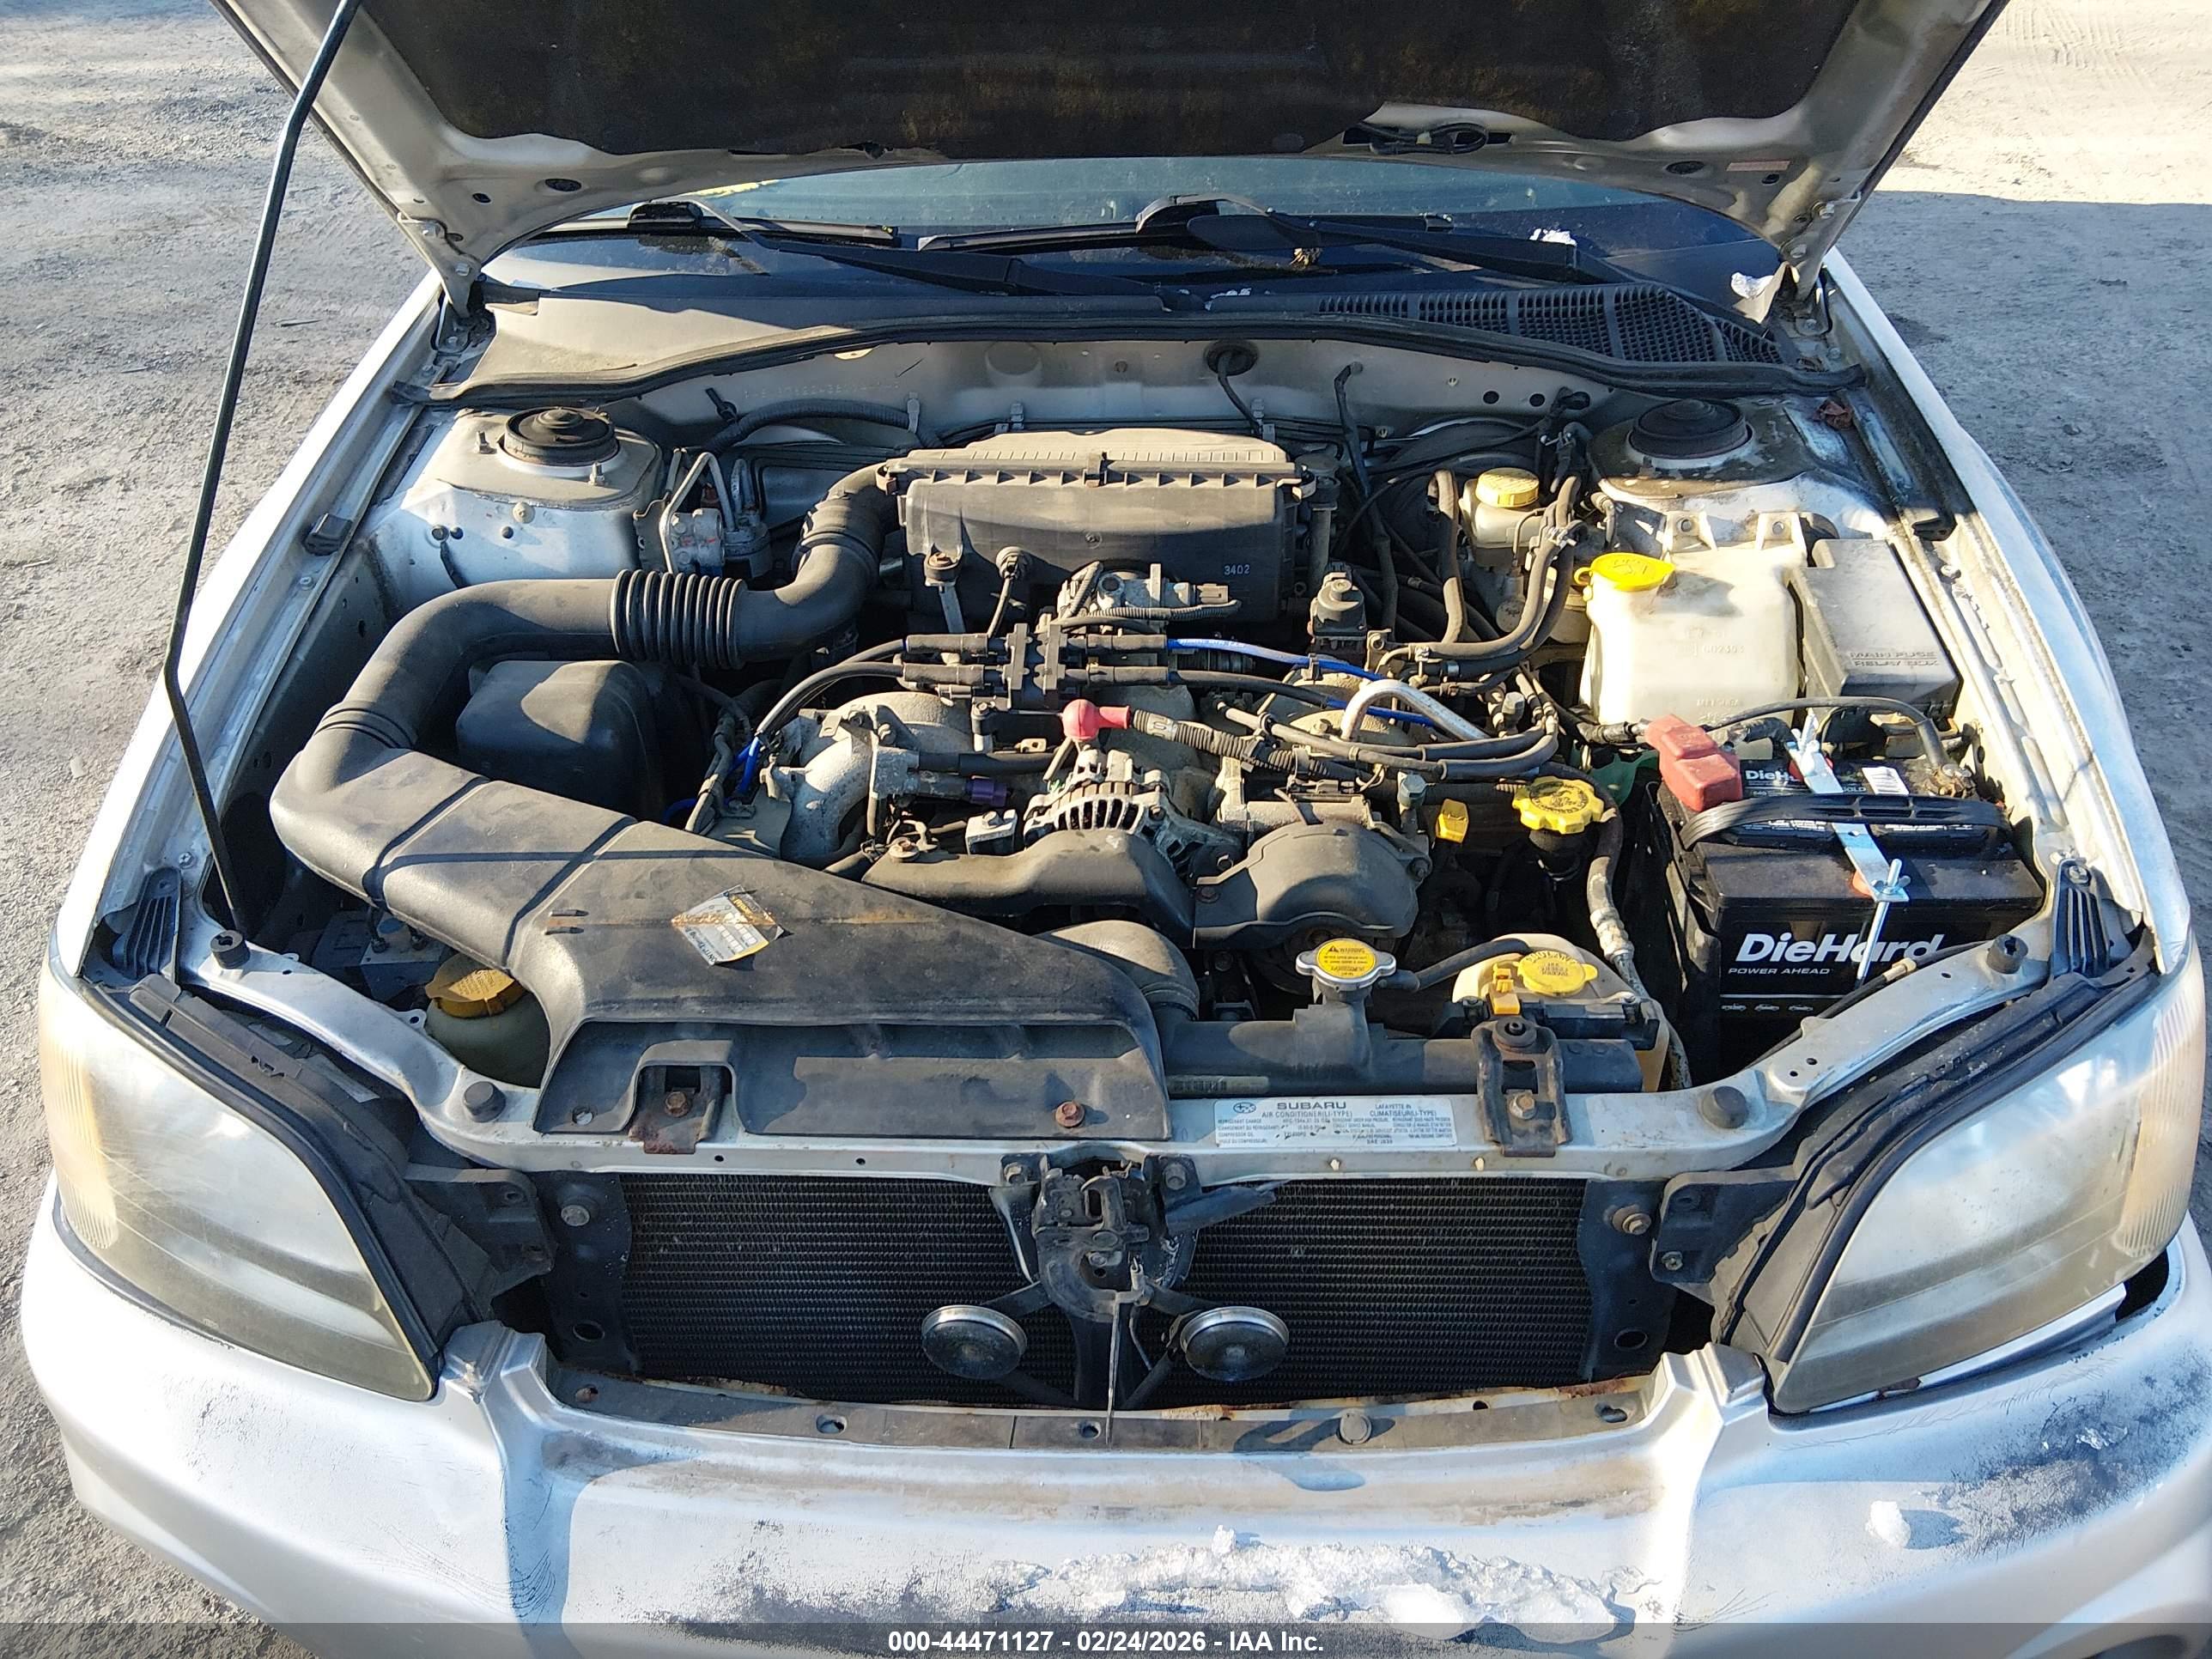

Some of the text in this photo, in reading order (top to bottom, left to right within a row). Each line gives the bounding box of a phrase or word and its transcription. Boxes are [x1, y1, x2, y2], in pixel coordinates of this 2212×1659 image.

[1224, 564, 1250, 575] 3402
[1735, 933, 1945, 963] DieHard
[1277, 1101, 1346, 1109] SUBARU
